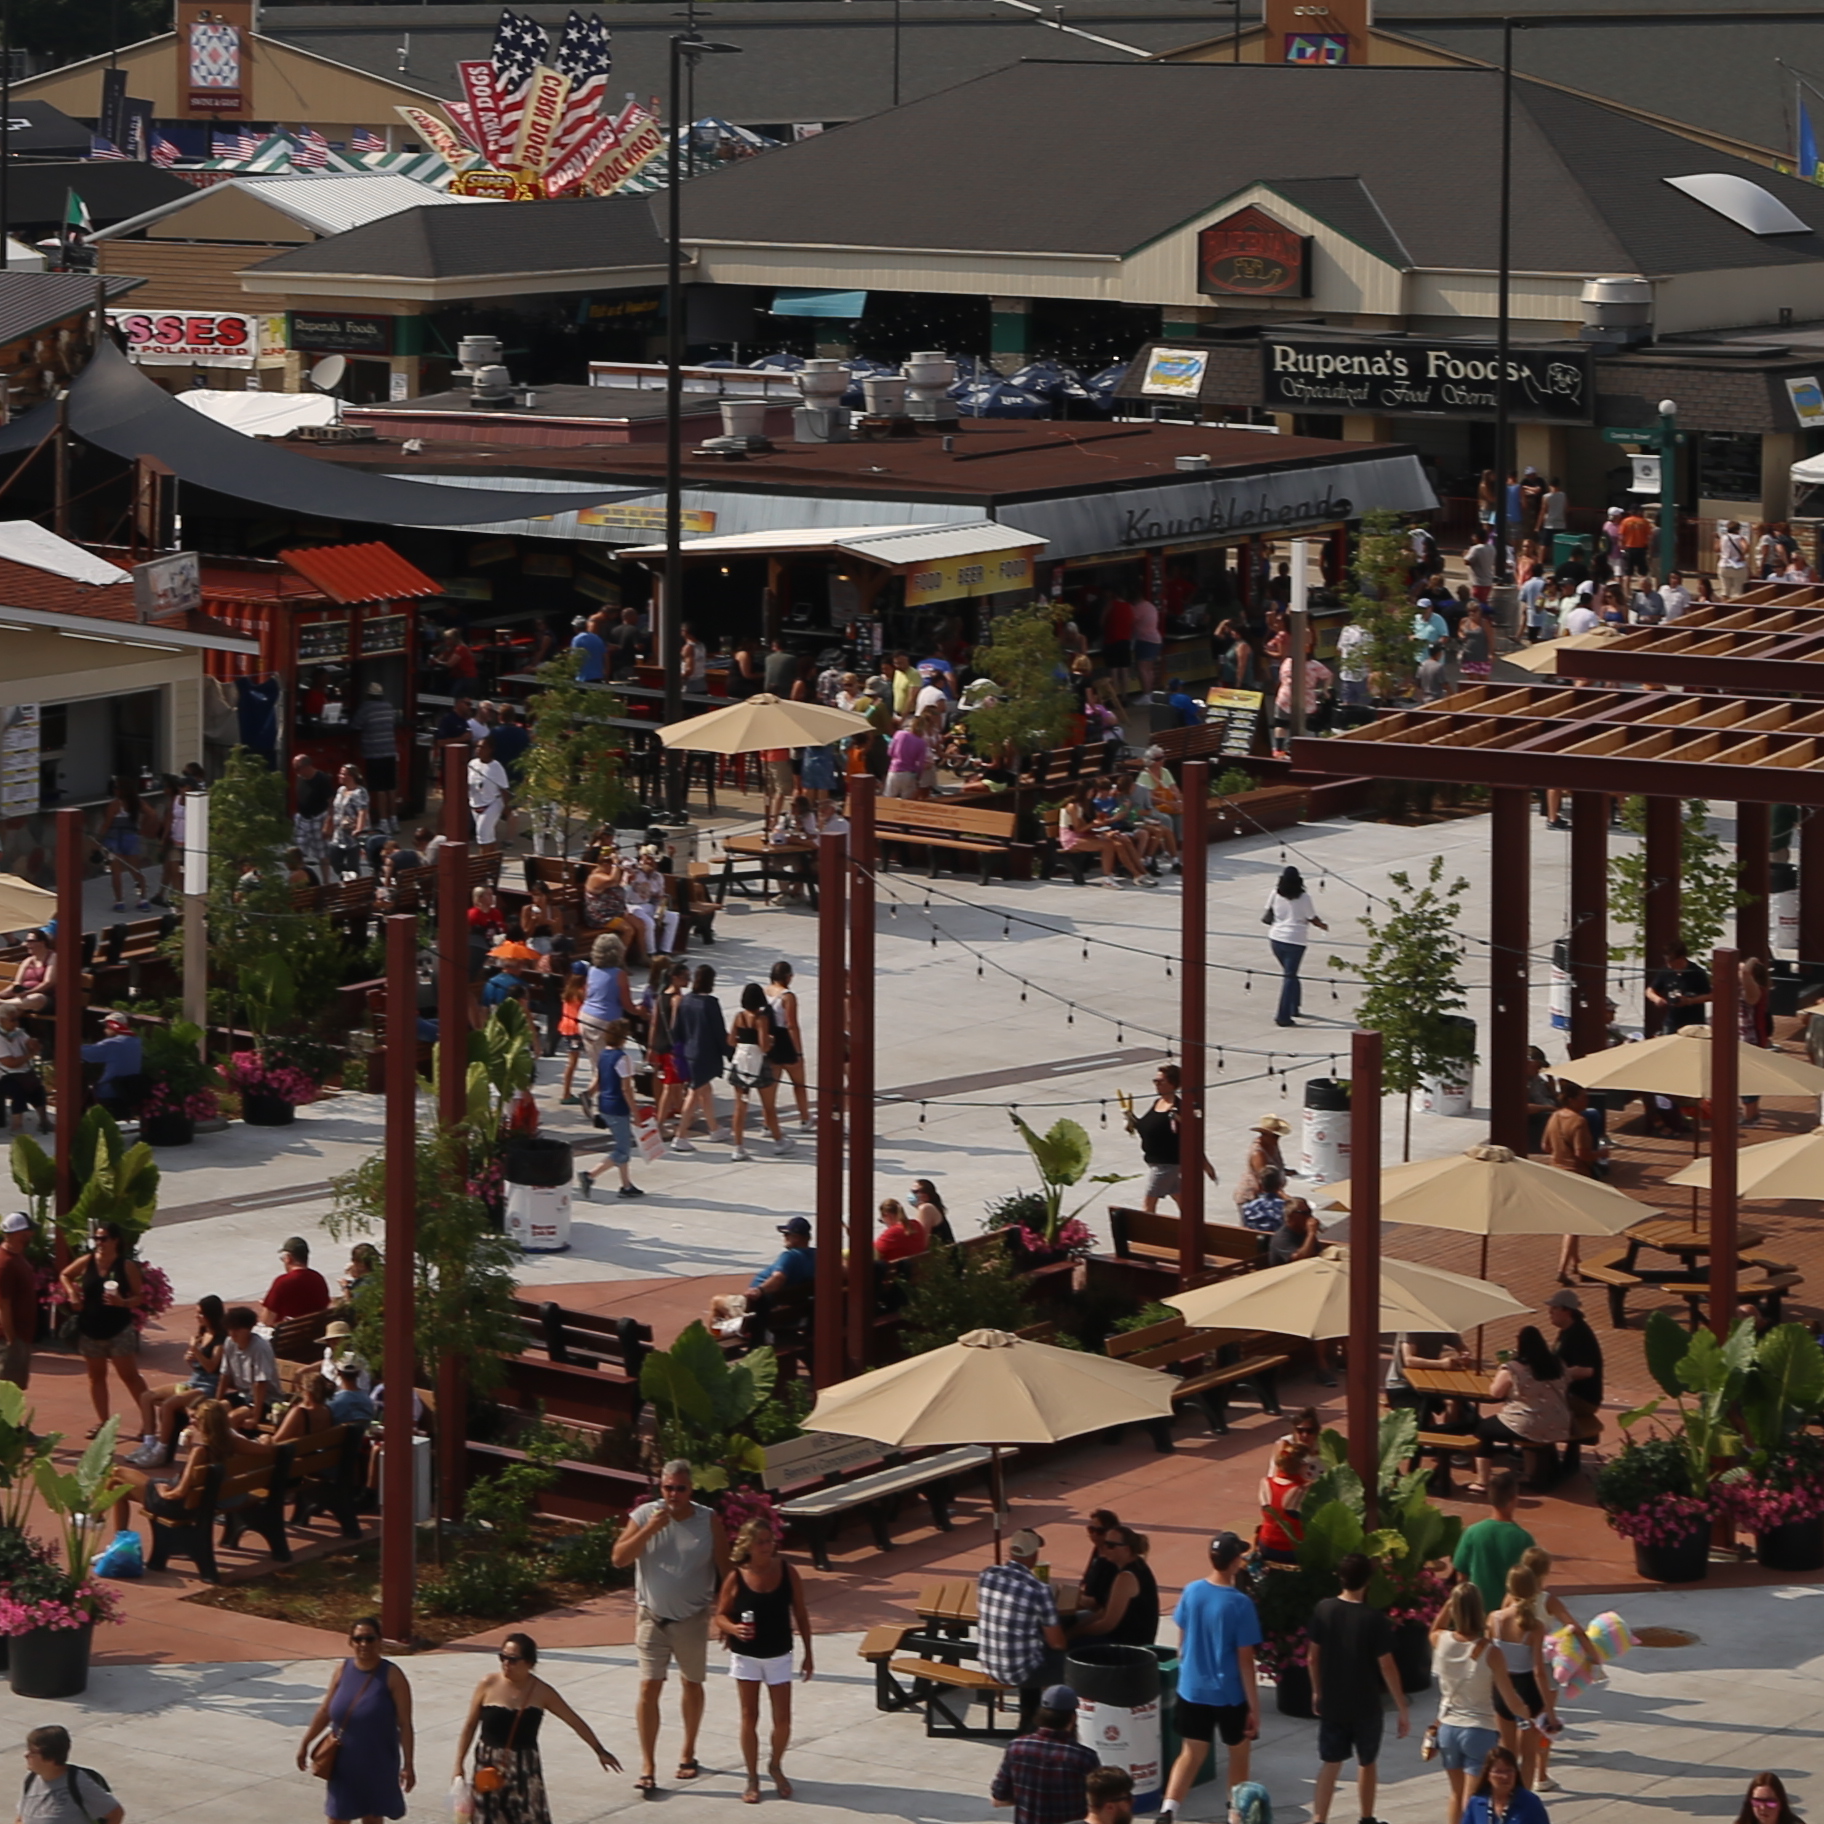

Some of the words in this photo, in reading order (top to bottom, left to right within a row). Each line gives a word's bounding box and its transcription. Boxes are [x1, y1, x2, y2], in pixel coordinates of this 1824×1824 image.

[467, 175, 512, 189] SUPER
[548, 156, 587, 193] CORN
[106, 315, 248, 346] SSES
[141, 345, 249, 356] POLARIZED
[1273, 344, 1410, 378] Rupena's
[915, 571, 942, 591] FOOD
[958, 565, 985, 586] BEER
[1000, 558, 1027, 579] FOOD
